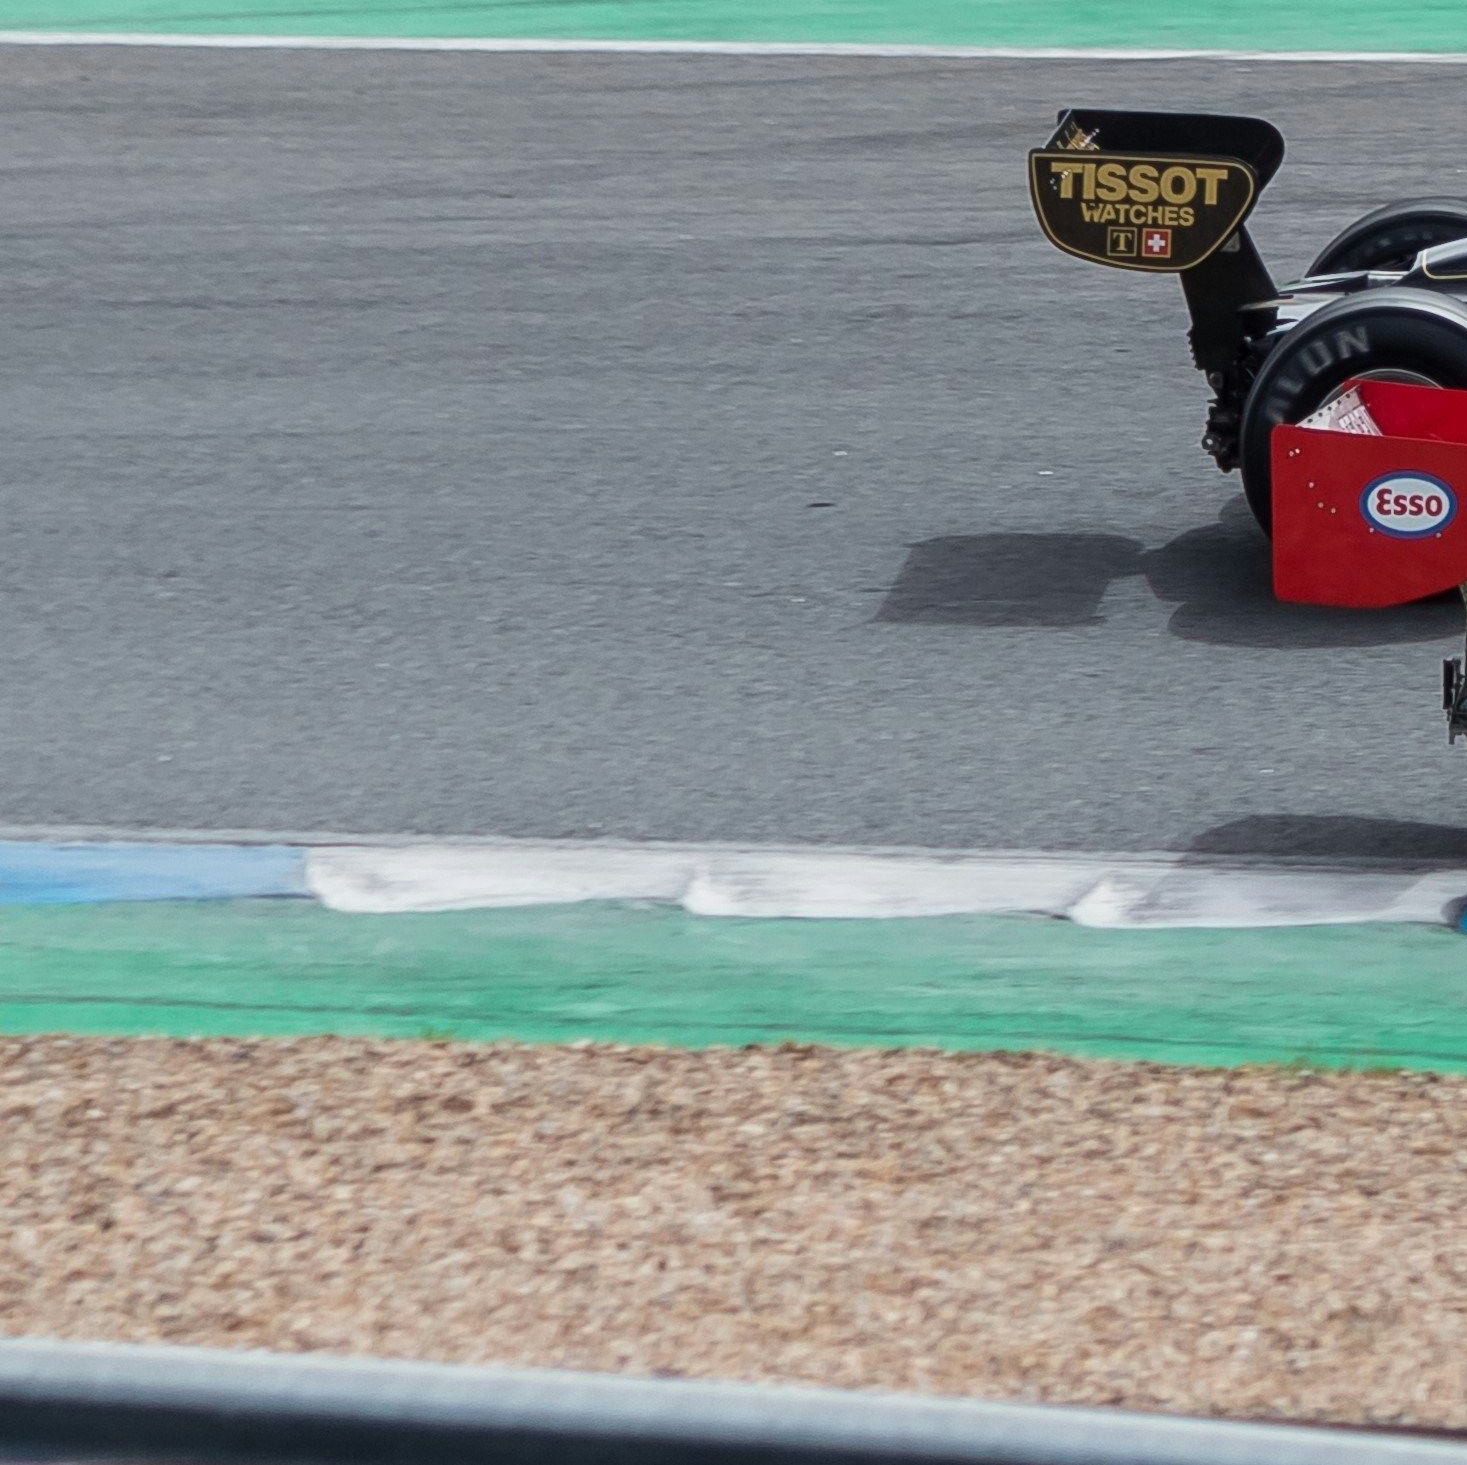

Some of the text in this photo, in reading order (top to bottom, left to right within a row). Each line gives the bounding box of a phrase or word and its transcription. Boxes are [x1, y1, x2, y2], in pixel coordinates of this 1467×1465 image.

[1051, 161, 1228, 205] TISSOT
[1081, 202, 1194, 226] WATCHES
[1113, 232, 1132, 252] T
